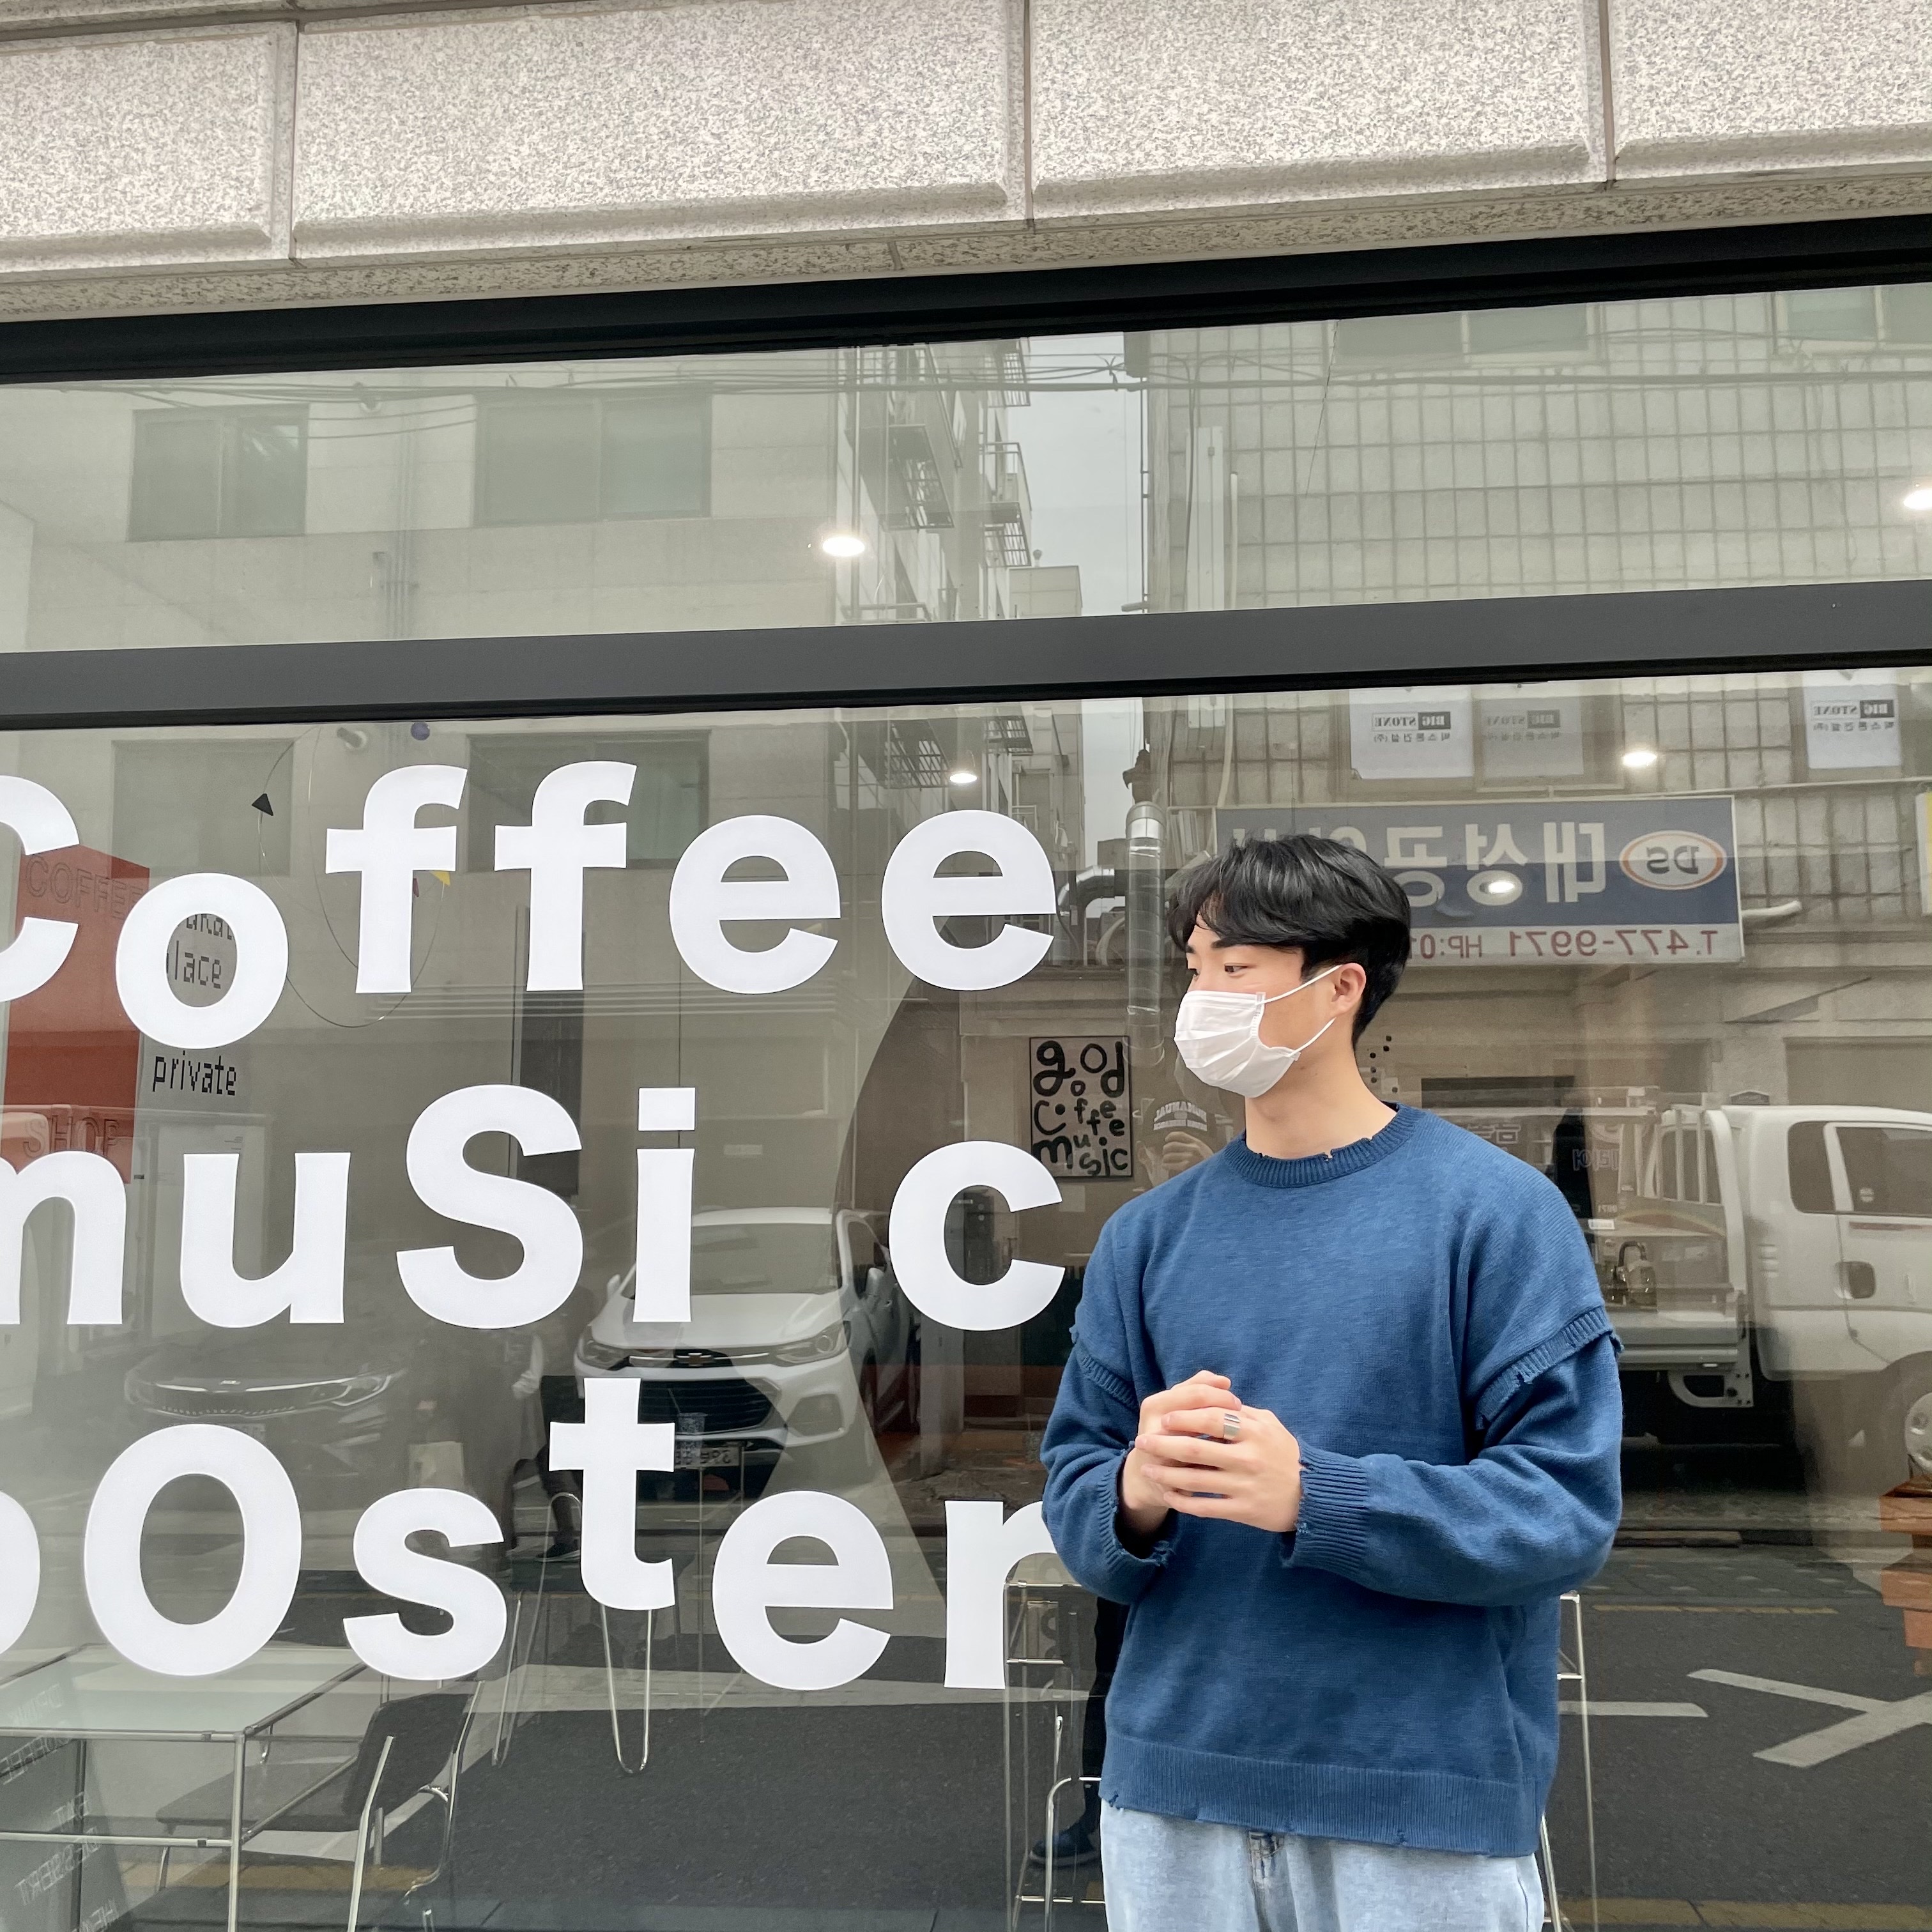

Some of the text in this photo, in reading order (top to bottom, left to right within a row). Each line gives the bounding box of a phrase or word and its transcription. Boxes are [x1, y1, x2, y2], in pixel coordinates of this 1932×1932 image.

[165, 940, 221, 990] lace
[152, 1050, 237, 1096] private
[22, 1114, 119, 1159] SHOP
